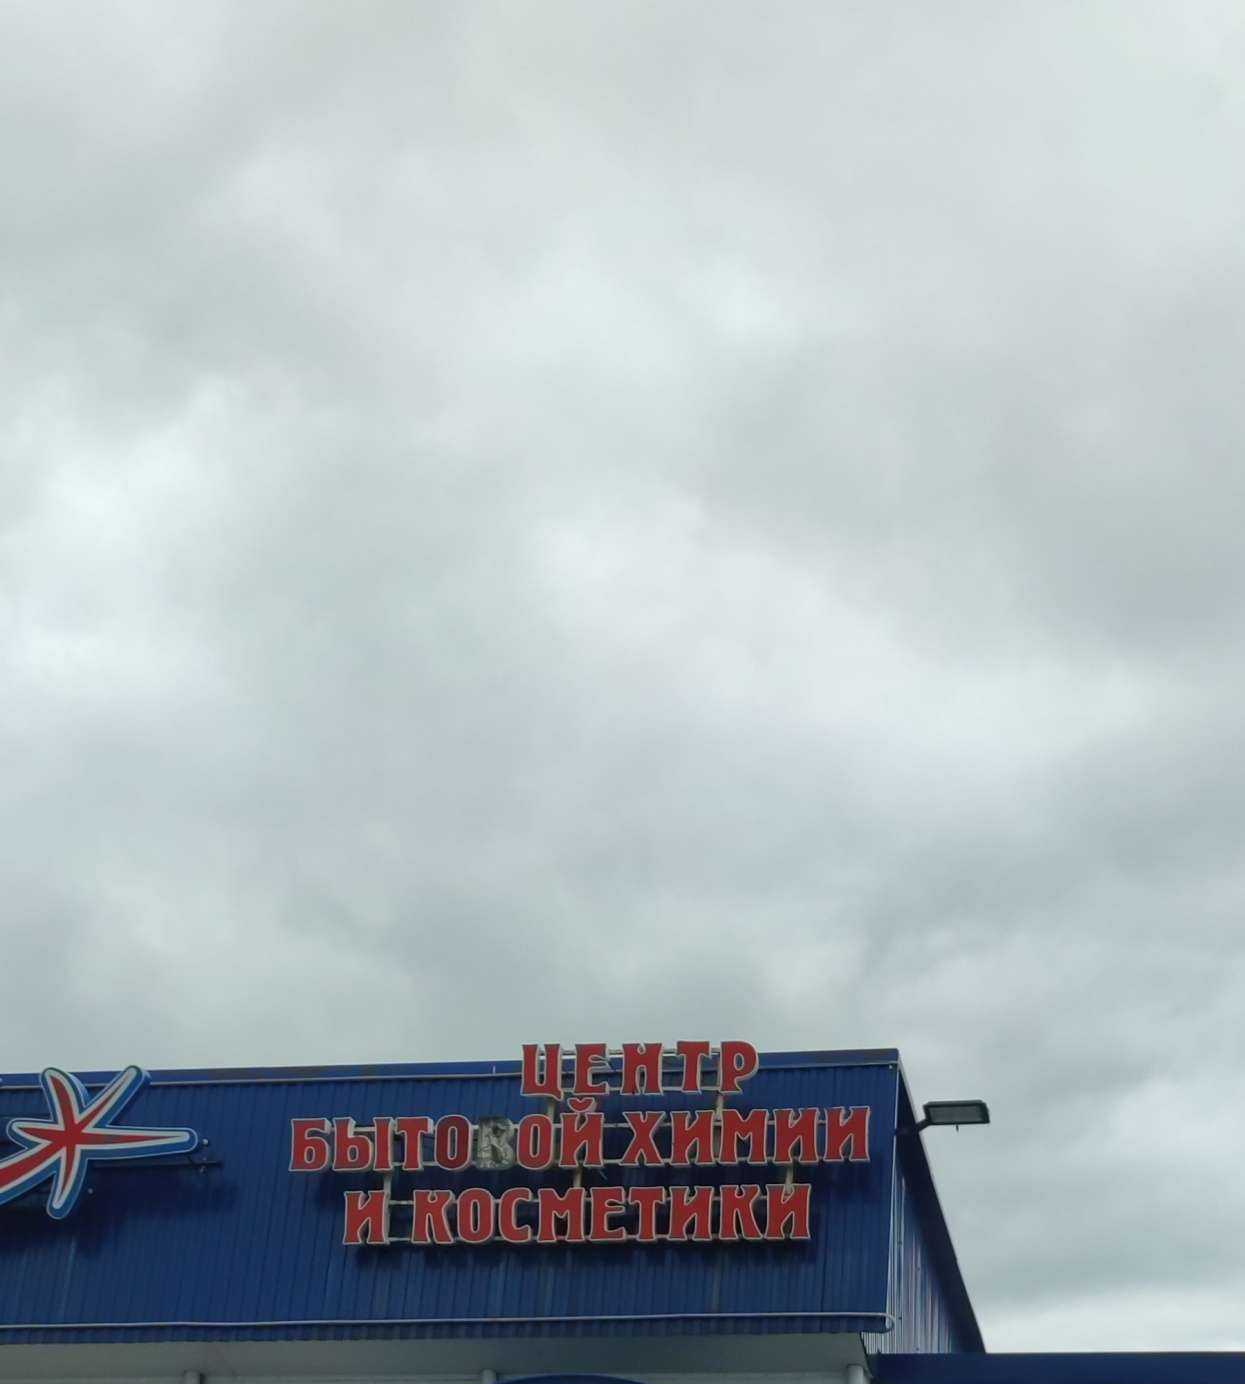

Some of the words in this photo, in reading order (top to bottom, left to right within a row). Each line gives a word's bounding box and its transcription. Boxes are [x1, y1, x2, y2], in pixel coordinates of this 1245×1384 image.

[521, 1042, 759, 1099] ЦЕНТР
[289, 1098, 605, 1172] БЫТОВОЙ
[620, 1106, 871, 1167] ХИМИИ
[342, 1190, 390, 1244] И
[411, 1184, 811, 1244] КОСМЕТИКИ
